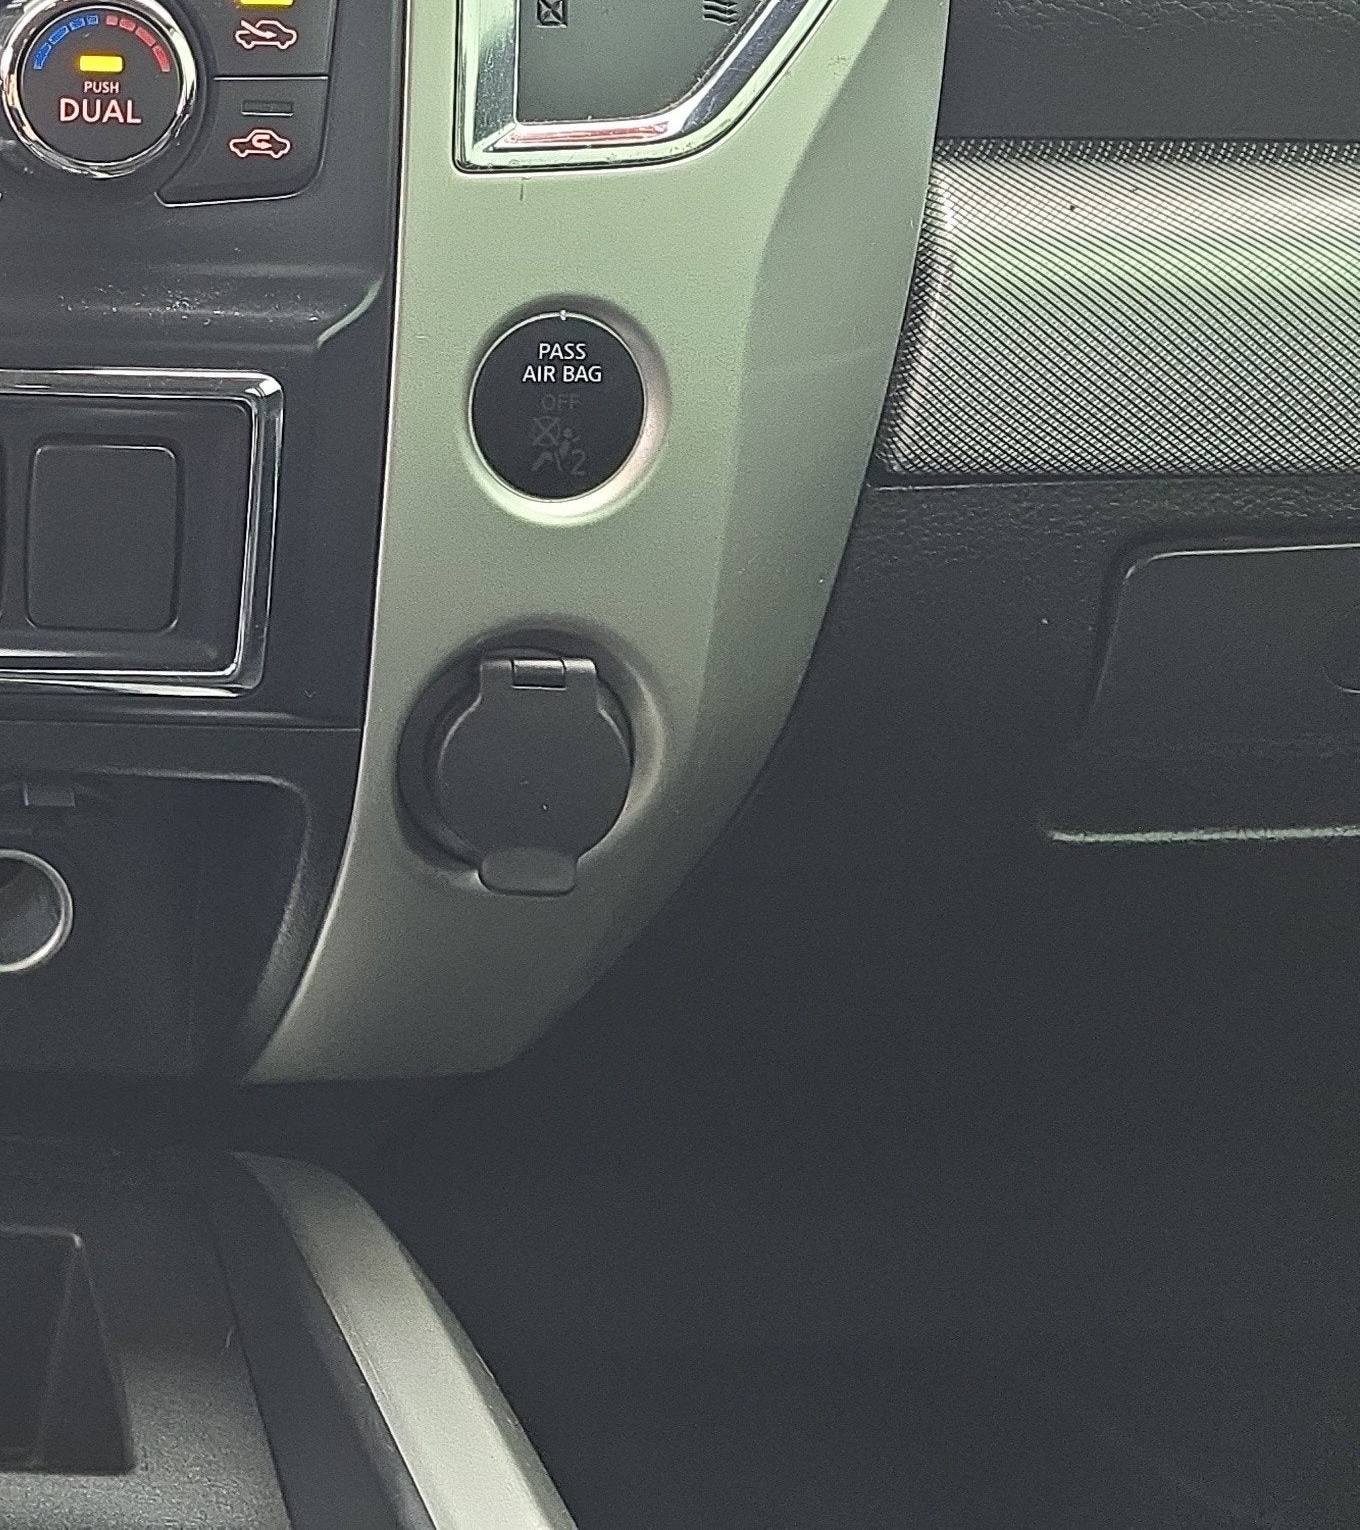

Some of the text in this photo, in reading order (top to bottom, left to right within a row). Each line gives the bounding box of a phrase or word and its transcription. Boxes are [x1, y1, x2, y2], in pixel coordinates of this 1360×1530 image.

[83, 81, 119, 94] PUSH
[59, 97, 142, 125] DUAL
[538, 343, 587, 360] PASS
[522, 365, 602, 382] AIR BAG
